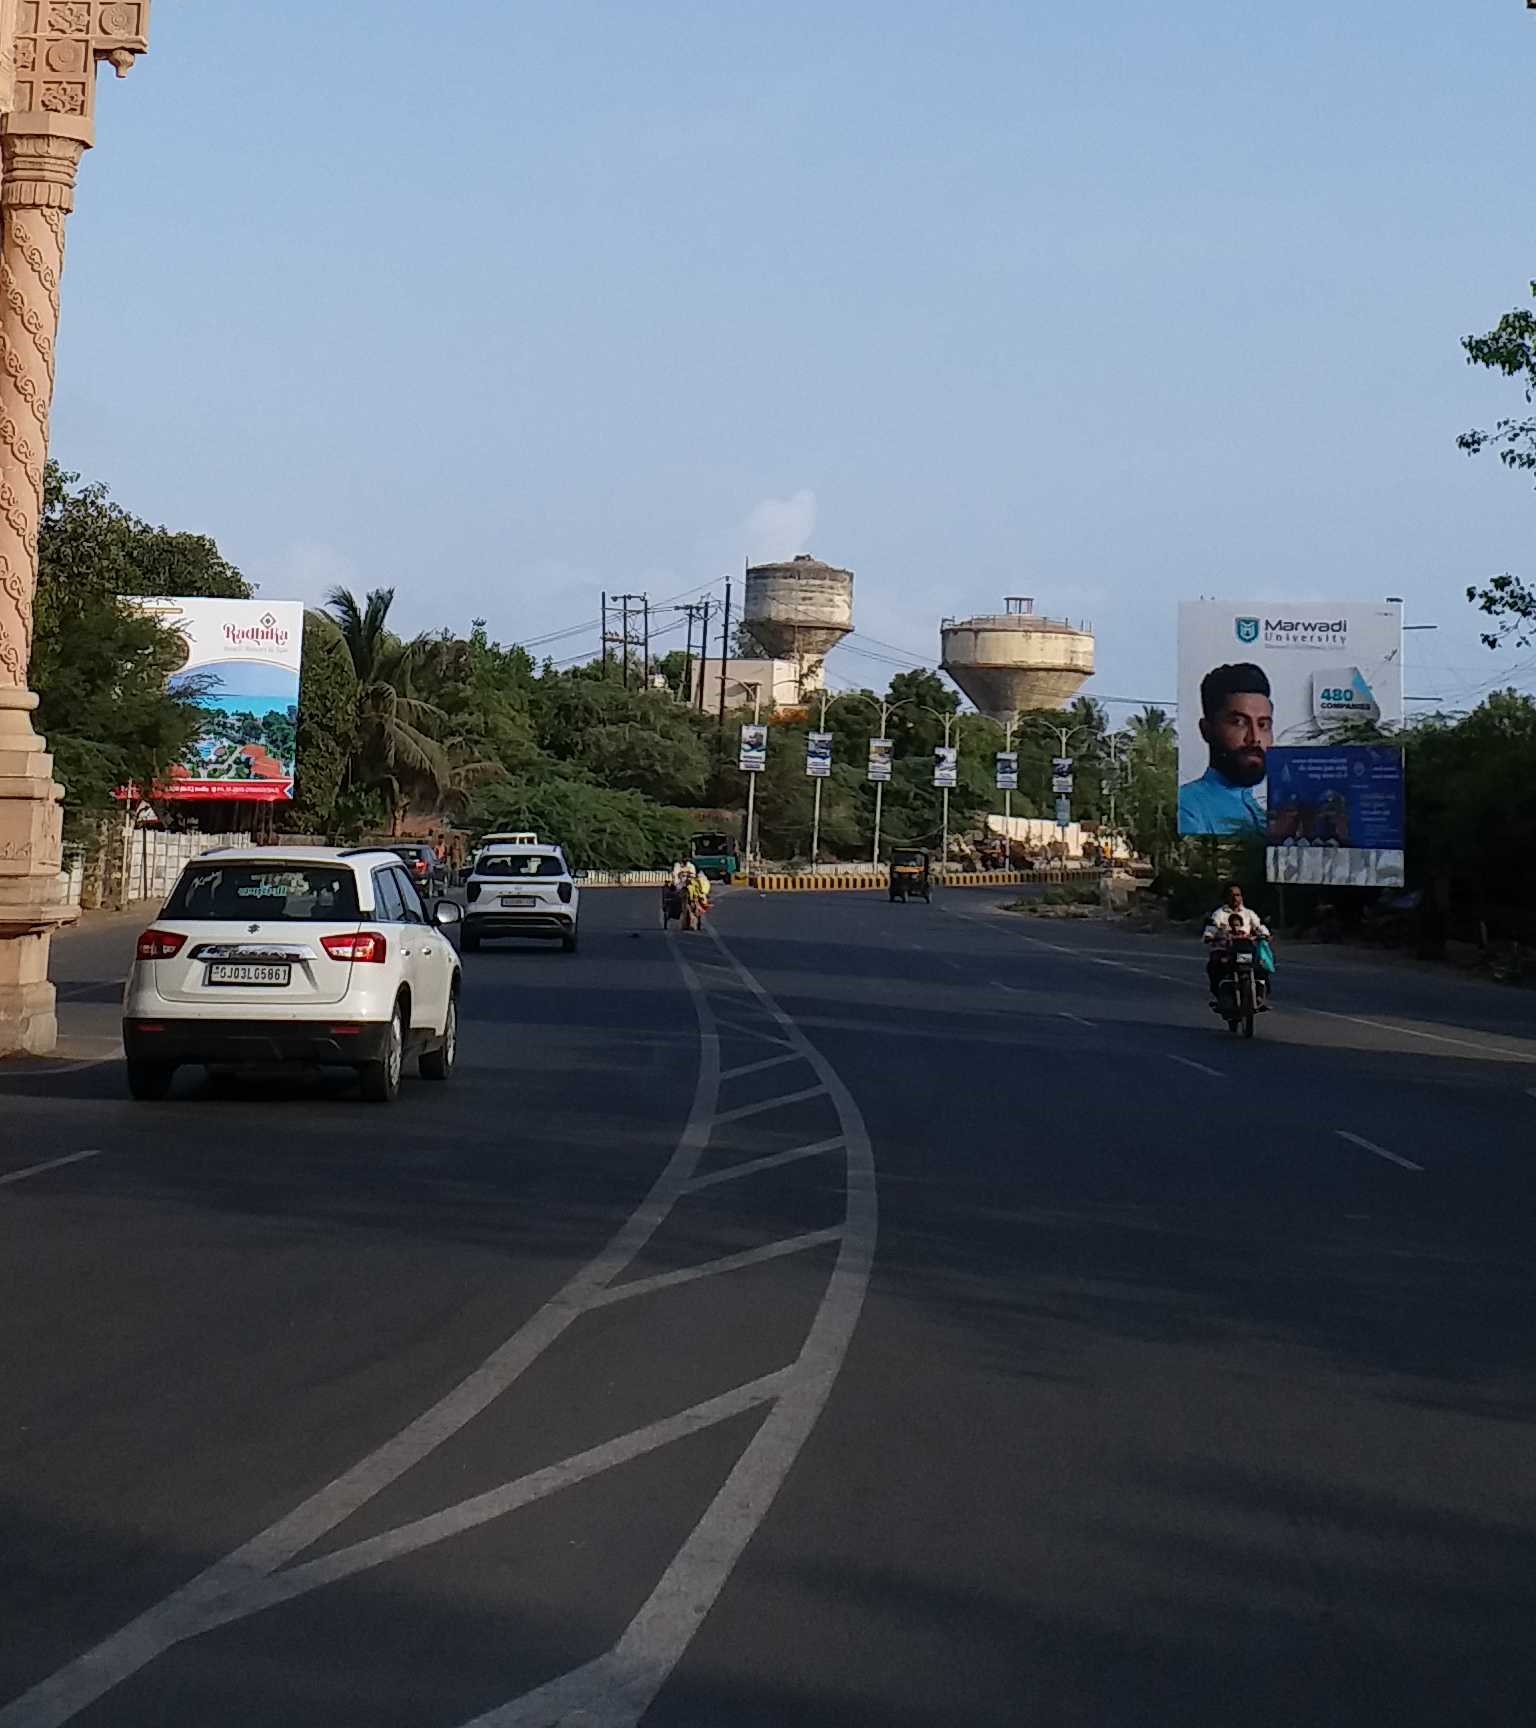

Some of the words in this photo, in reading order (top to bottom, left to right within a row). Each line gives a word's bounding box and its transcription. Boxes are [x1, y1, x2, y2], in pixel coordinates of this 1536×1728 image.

[1265, 619, 1347, 632] Marwadi
[223, 623, 288, 646] Radhika
[1265, 632, 1346, 644] University
[1321, 688, 1353, 701] 480
